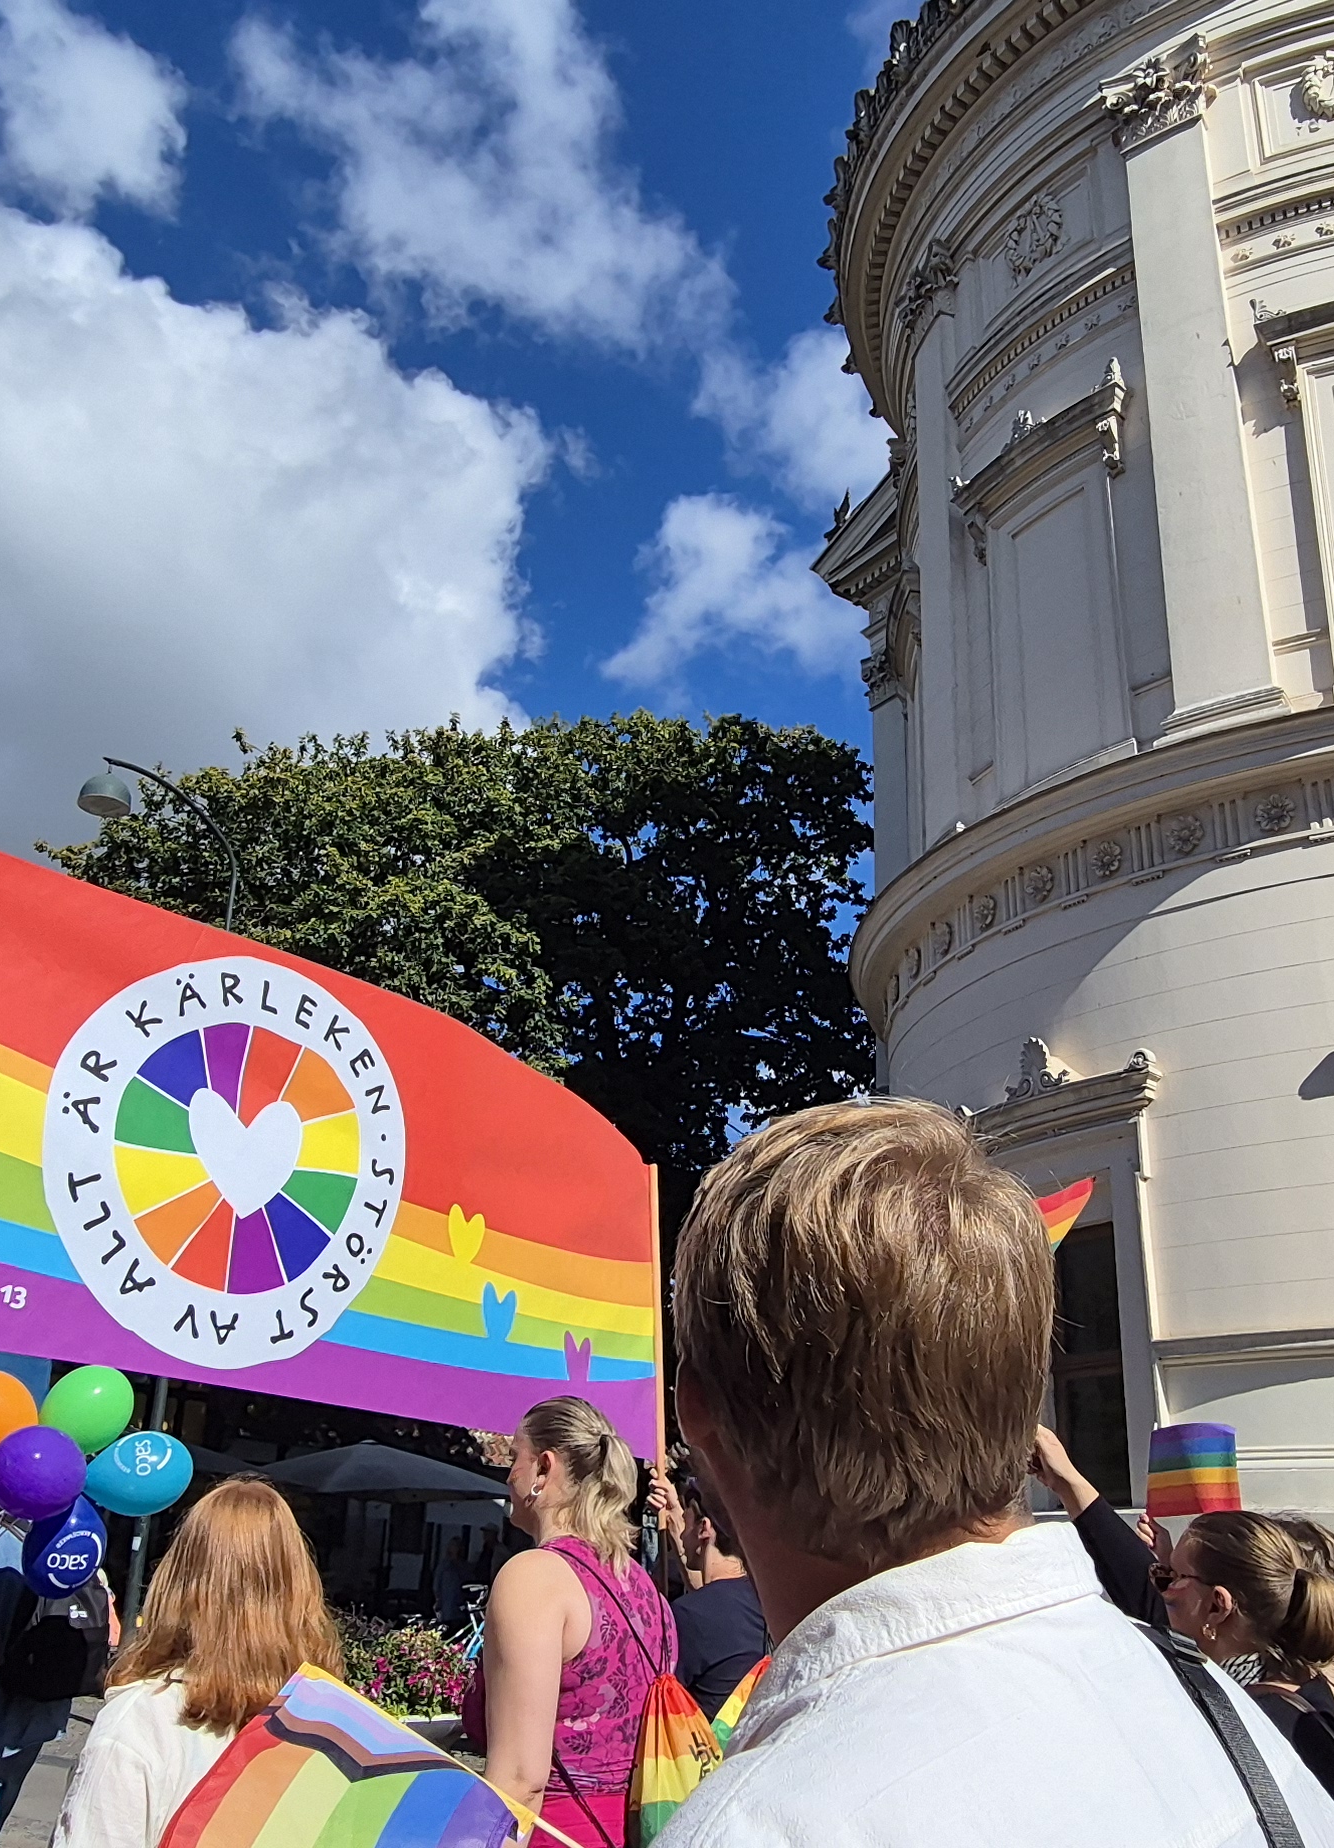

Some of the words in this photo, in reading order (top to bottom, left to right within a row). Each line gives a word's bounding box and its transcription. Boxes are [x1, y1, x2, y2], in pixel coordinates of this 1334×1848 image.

[62, 1049, 117, 1133] ÄR
[67, 1172, 156, 1295] ALLT
[270, 1158, 395, 1344] STÖRST
[0, 1284, 27, 1310] 13
[174, 1304, 239, 1345] AV
[134, 1439, 152, 1476] saco
[46, 1552, 89, 1570] saco
